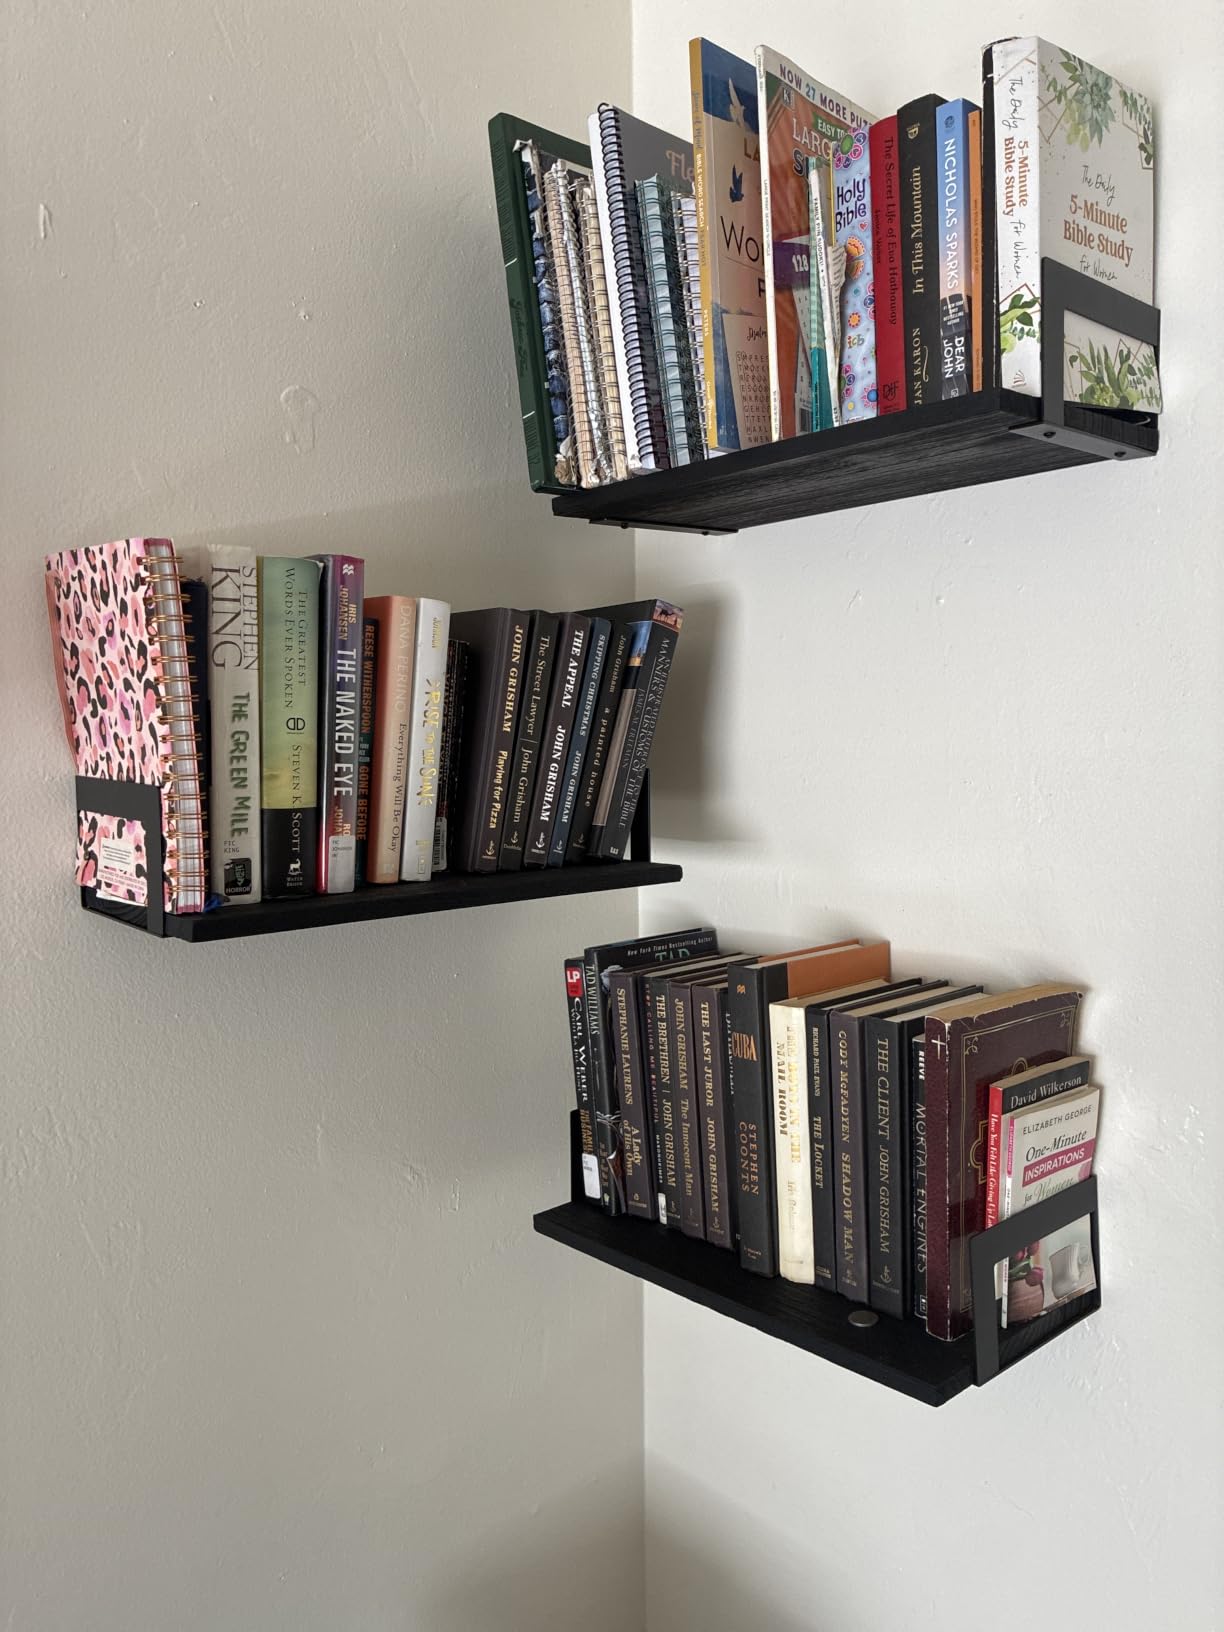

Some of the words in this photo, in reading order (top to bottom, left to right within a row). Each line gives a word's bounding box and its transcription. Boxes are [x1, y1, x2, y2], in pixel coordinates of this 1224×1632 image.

[780, 64, 803, 91] NOW
[805, 83, 816, 101] 27
[820, 92, 848, 120] MORE
[1009, 77, 1023, 97] The
[817, 119, 836, 138] EASY
[1002, 98, 1024, 130] Daily
[884, 136, 894, 160] The
[1004, 137, 1016, 173] Bible
[885, 162, 896, 199] Secret
[944, 138, 958, 228] NICHOLAS
[1018, 140, 1031, 208] 5-Minute
[1081, 165, 1095, 188] The
[1094, 171, 1115, 206] Daily
[836, 178, 866, 210] Holy
[911, 166, 923, 239] Mountain
[1002, 174, 1016, 217] Study
[835, 202, 867, 234] Bible
[885, 202, 897, 224] Life
[1010, 219, 1025, 240] for
[1069, 194, 1128, 234] 5-Minute
[888, 227, 897, 239] of
[1063, 218, 1095, 250] Bible
[1098, 233, 1134, 267] Study
[792, 254, 809, 273] 128
[911, 243, 924, 272] This
[945, 232, 959, 289] SPARKS
[1013, 241, 1025, 280] Women
[913, 279, 925, 294] In
[912, 327, 922, 377] KARON
[943, 339, 954, 379] JOHN
[954, 336, 967, 373] DEAR
[914, 381, 923, 406] JAN
[284, 567, 295, 616] WORDS
[298, 591, 308, 616] THE
[211, 566, 243, 670] KING
[242, 565, 260, 670] STEPHEN
[338, 585, 349, 640] JOHANSEN
[349, 604, 357, 624] IRIS
[400, 606, 412, 649] DANA
[284, 619, 294, 652] EVER
[298, 619, 308, 687] GREATEST
[363, 624, 375, 657] REESE
[511, 625, 523, 663] JOHN
[539, 636, 549, 657] The
[571, 629, 584, 657] THE
[616, 635, 627, 653] John
[336, 648, 357, 684] THE
[591, 634, 606, 679] SKIPPING
[650, 638, 671, 691] MANNERS
[284, 657, 295, 708] SPOKEN
[395, 656, 409, 713] PERINO
[533, 659, 546, 693] Street
[561, 657, 578, 708] APPEAL
[609, 658, 622, 693] Grisham
[231, 691, 250, 723] THE
[360, 661, 374, 734] WITHERSPOON
[502, 666, 518, 732] GRISHAM
[526, 695, 541, 736] Lawyer
[579, 681, 597, 737] CHRISTMAS
[334, 690, 356, 755] NAKED
[635, 707, 655, 757] CUSTOMS
[229, 730, 250, 790] GREEN
[393, 722, 408, 787] Everything
[520, 748, 533, 773] John
[551, 725, 566, 760] JOHN
[594, 718, 609, 767] painted
[291, 744, 302, 790] STEVEN
[333, 763, 353, 796] EYE
[358, 766, 369, 795] GONE
[493, 750, 508, 785] Playing
[571, 750, 582, 777] JOHN
[394, 787, 404, 805] Will
[493, 786, 504, 801] for
[513, 777, 528, 823] Grisham
[540, 763, 559, 822] GRISHAM
[562, 779, 577, 823] GRISHAM
[584, 771, 598, 807] house
[626, 777, 638, 799] THE
[230, 796, 251, 837] MILE
[291, 812, 303, 851] SCOTT
[356, 799, 368, 840] BEFORE
[393, 808, 401, 823] Be
[489, 803, 501, 829] Pizza
[618, 800, 632, 829] BIBLE
[388, 825, 400, 853] Okay
[566, 970, 581, 983] LP
[585, 964, 596, 985] TAD
[573, 997, 583, 1038] CARL
[587, 987, 600, 1035] WILLIAMS
[616, 988, 630, 1048] STEPHANIE
[656, 995, 666, 1019] THE
[674, 998, 685, 1031] JOHN
[700, 1001, 710, 1028] THE
[646, 1012, 655, 1050] CALLING
[702, 1030, 712, 1063] LAST
[731, 1031, 757, 1062] CUBA
[812, 1026, 820, 1055] RICHARD
[838, 1030, 848, 1067] CODY
[657, 1022, 670, 1084] BRETHREN
[676, 1034, 688, 1090] GRISHAM
[777, 1041, 787, 1085] MAIL
[877, 1039, 889, 1073] THE
[918, 1050, 926, 1081] REEVE
[576, 1046, 588, 1102] WEBER
[621, 1052, 633, 1105] LAURENS
[703, 1064, 715, 1107] JUROR
[1010, 1091, 1037, 1110] David
[1039, 1075, 1082, 1097] Wilkerson
[662, 1099, 674, 1130] JOHN
[679, 1098, 689, 1120] The
[778, 1089, 789, 1137] ROOM
[839, 1071, 850, 1143] McFADYEN
[877, 1076, 890, 1141] CLIENT
[989, 1114, 999, 1131] Have
[1022, 1116, 1063, 1135] ELIZABETH
[1064, 1104, 1092, 1121] GEORGE
[680, 1123, 692, 1169] Innocent
[706, 1117, 717, 1150] JOHN
[813, 1116, 822, 1139] THE
[914, 1103, 927, 1178] MORTAL
[989, 1132, 998, 1146] You
[1025, 1130, 1088, 1162] One-Minute
[664, 1133, 677, 1187] GRISHAM
[739, 1121, 750, 1192] COONTS
[748, 1123, 759, 1196] STEPHEN
[814, 1143, 825, 1188] LOCKET
[879, 1144, 890, 1185] JOHN
[988, 1161, 997, 1176] Like
[1024, 1147, 1085, 1182] INSPIRATIONS
[684, 1171, 694, 1196] Man
[707, 1153, 720, 1212] GRISHAM
[841, 1152, 853, 1224] SHADOW
[987, 1177, 997, 1202] Giving
[1023, 1193, 1033, 1206] for
[879, 1186, 891, 1254] GRISHAM
[915, 1189, 927, 1273] ENGINES
[842, 1225, 854, 1265] MAN
